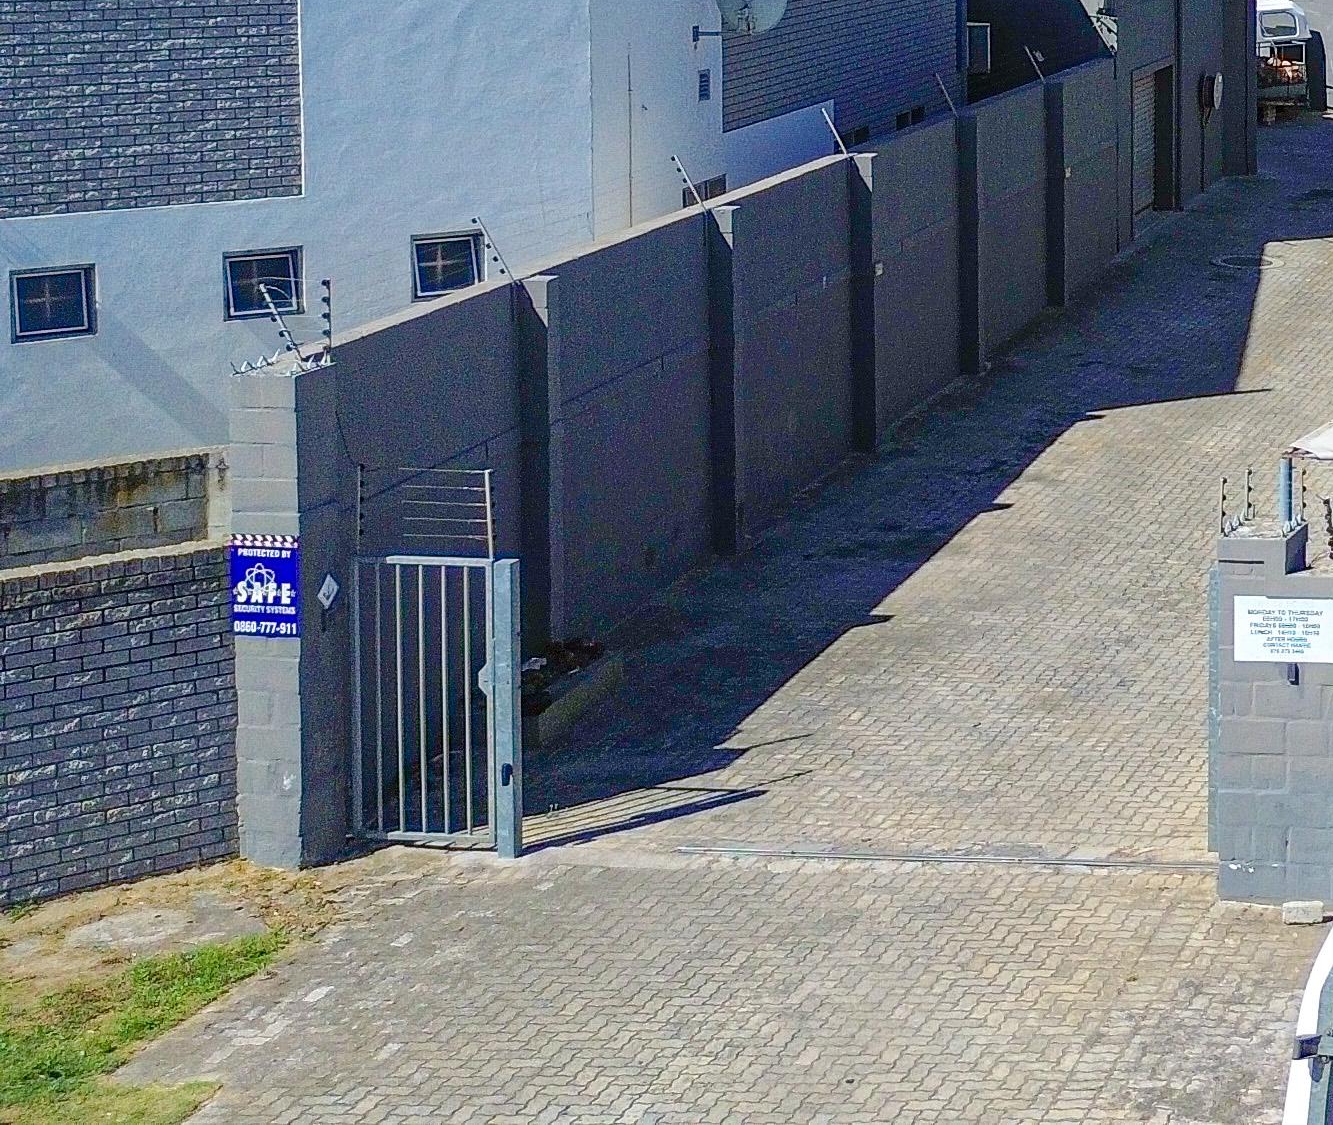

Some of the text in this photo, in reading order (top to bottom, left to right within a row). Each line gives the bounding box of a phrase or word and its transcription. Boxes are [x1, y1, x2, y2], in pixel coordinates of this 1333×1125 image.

[237, 548, 291, 558] PROTECTED BY
[237, 581, 291, 604] SAFE
[233, 604, 296, 614] SECURITY SYSTEMS
[233, 620, 297, 635] 0860-777-911
